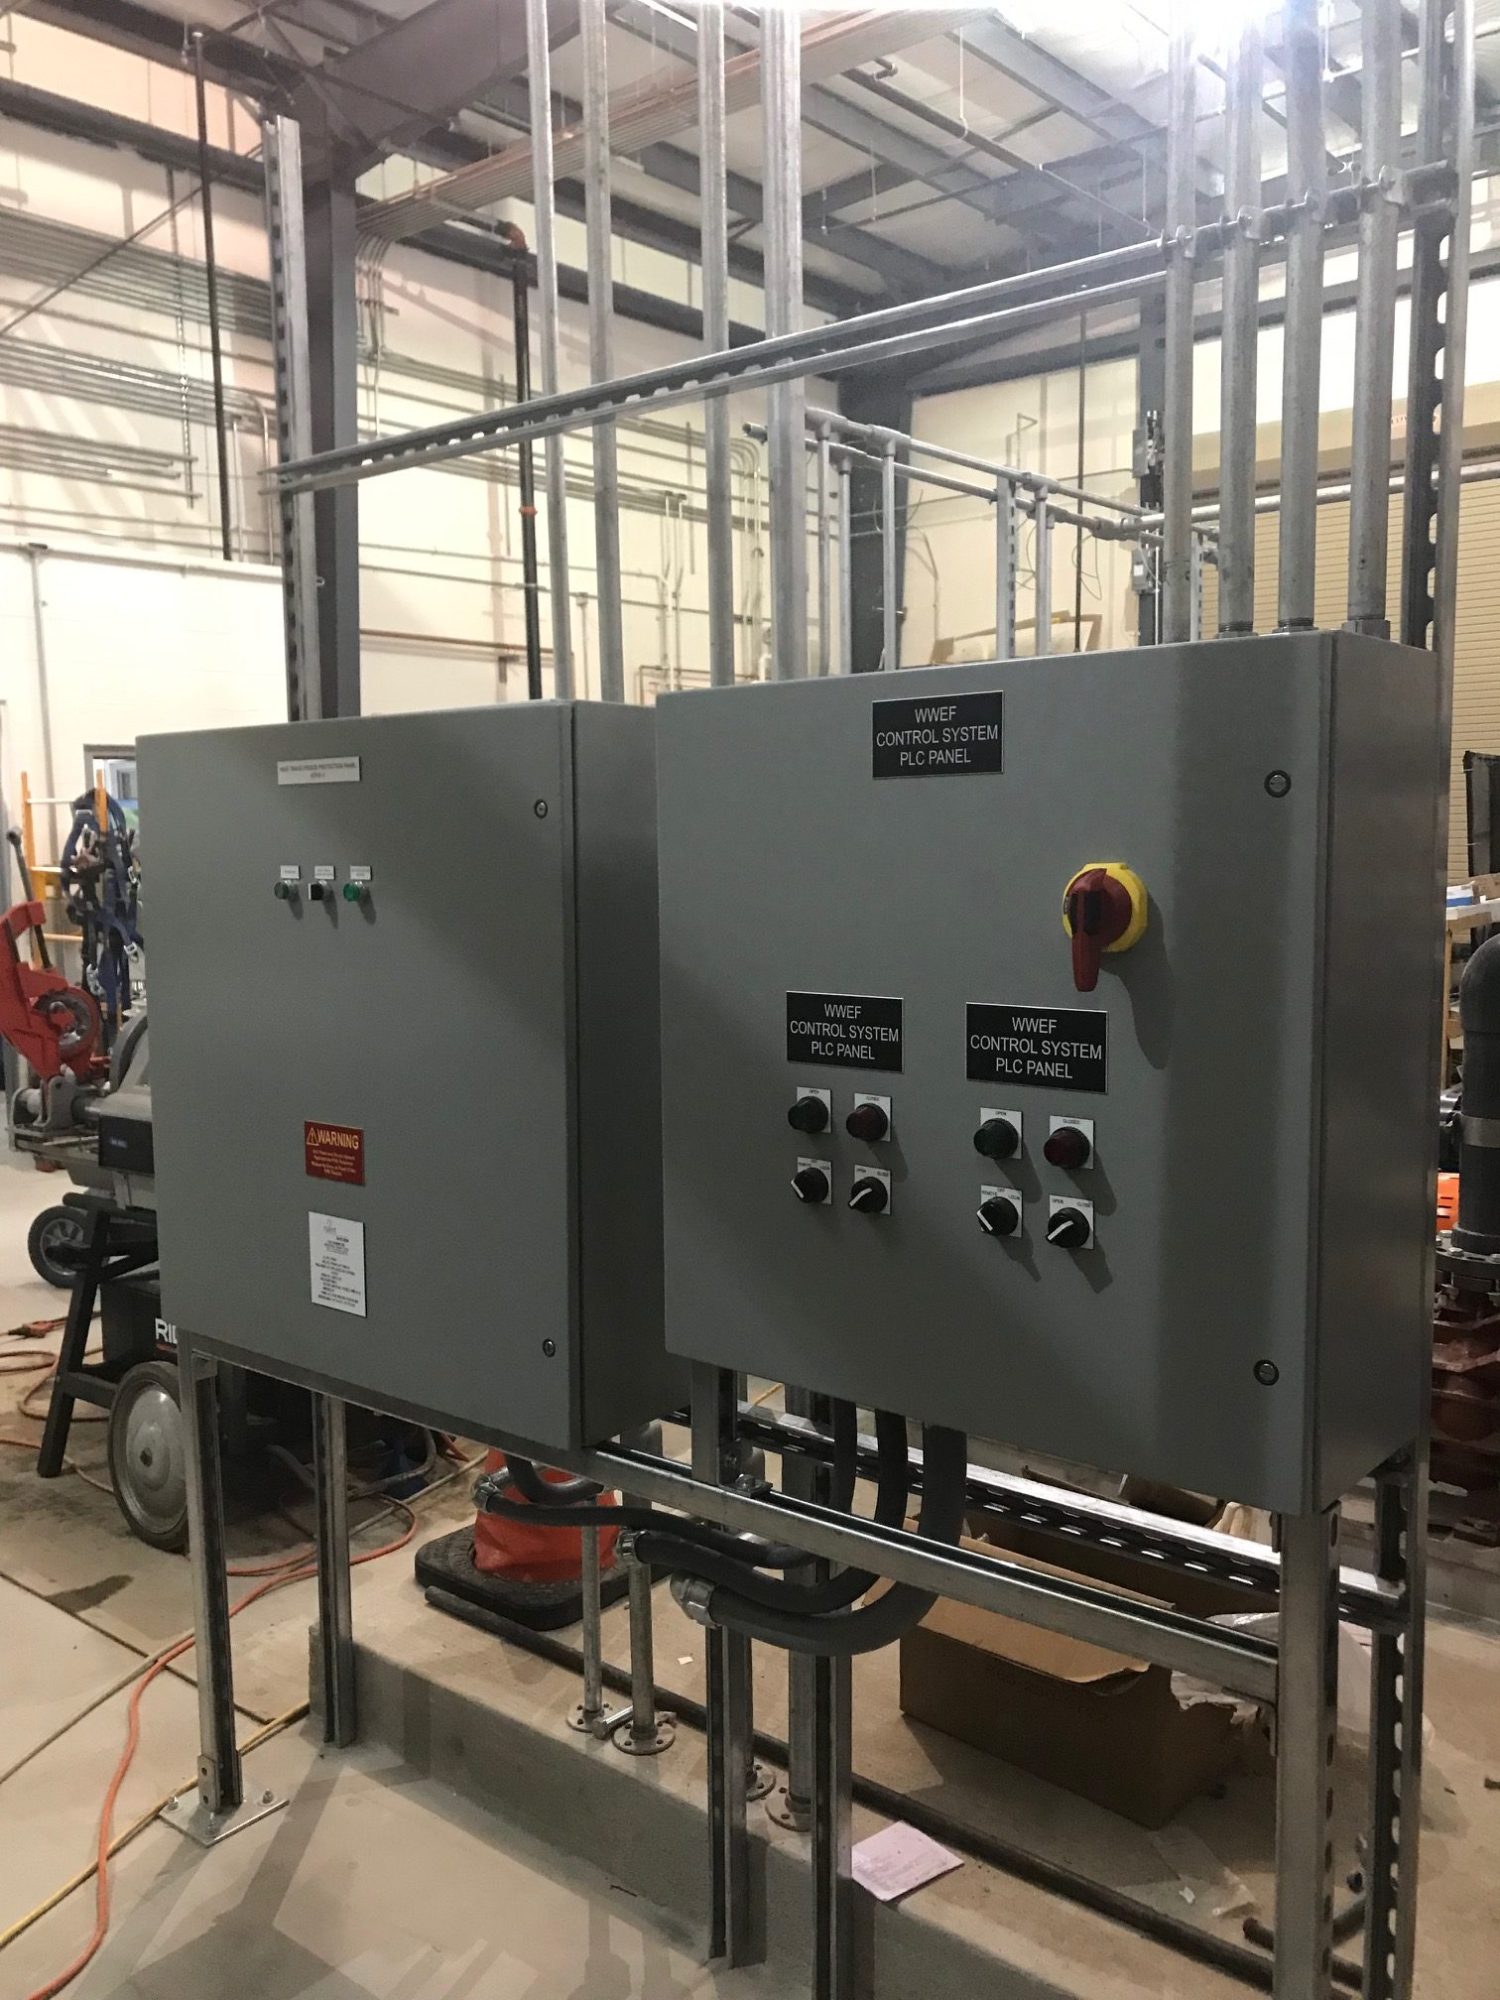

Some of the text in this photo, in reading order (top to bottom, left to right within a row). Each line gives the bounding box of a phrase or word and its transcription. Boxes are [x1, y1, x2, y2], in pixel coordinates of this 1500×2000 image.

[914, 705, 957, 723] WWEF
[876, 724, 998, 747] CONTROL SYSTEM
[900, 747, 971, 766] PLC PANEL
[824, 1003, 862, 1019] WWEF
[790, 1020, 899, 1042] CONTROL SYSTEM
[1012, 1016, 1058, 1034] WWEF
[811, 1041, 875, 1060] PLC PANEL
[970, 1034, 1102, 1060] CONTROL SYSTEM
[996, 1057, 1073, 1079] PLC PANEL
[317, 1128, 359, 1150] WARNING
